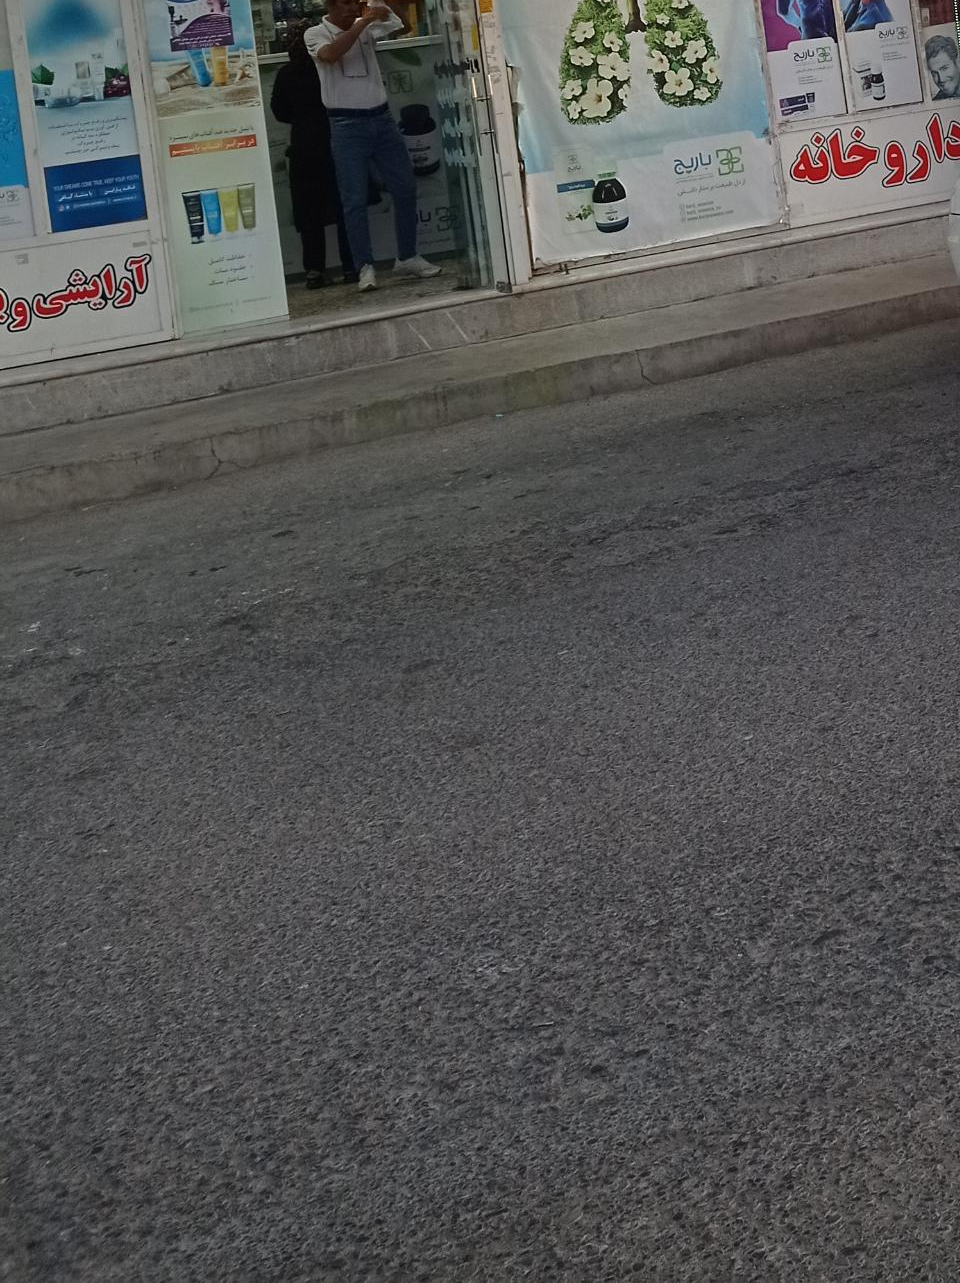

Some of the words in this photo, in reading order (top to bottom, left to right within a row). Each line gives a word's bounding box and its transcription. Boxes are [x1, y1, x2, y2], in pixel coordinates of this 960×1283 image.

[674, 151, 712, 175] باریج
[32, 254, 151, 318] آرایشی
[7, 297, 32, 332] و
